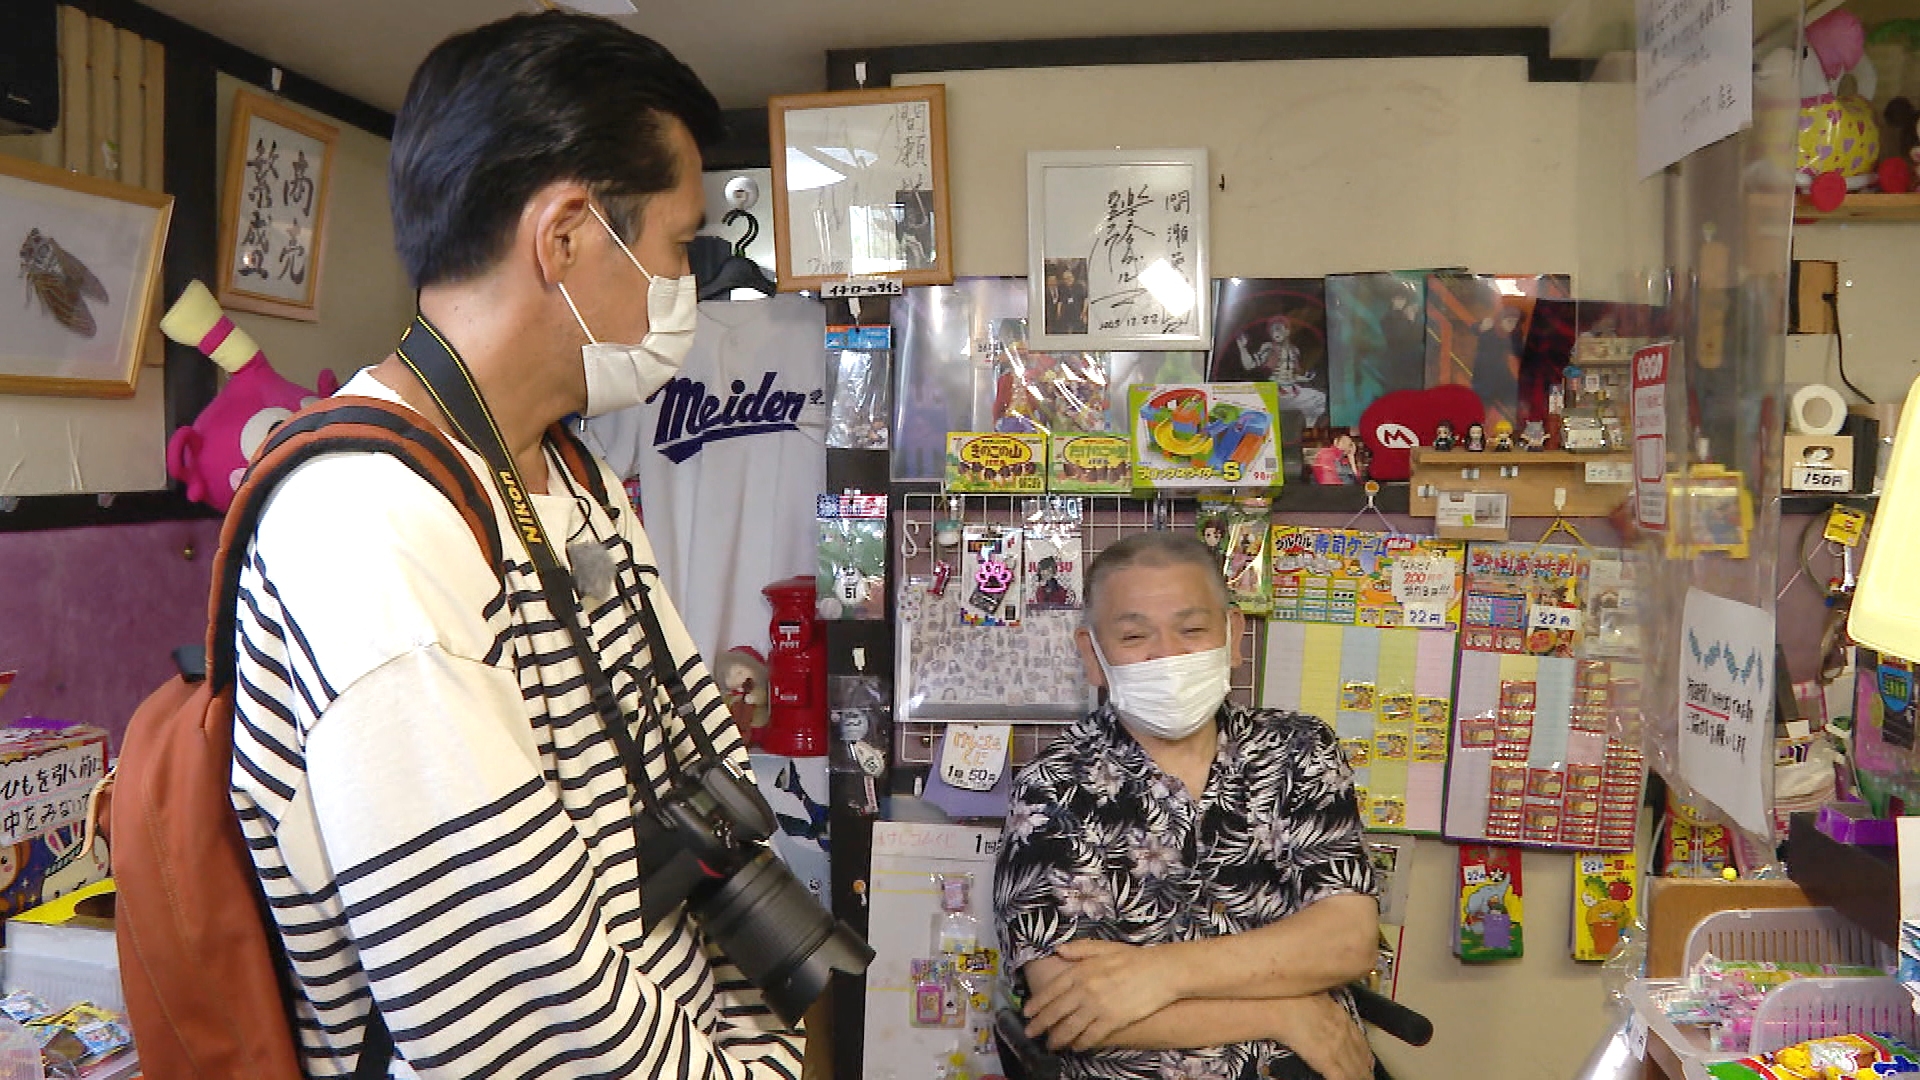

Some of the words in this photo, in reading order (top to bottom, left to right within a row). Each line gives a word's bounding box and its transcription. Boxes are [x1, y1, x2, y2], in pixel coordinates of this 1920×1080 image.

[644, 371, 806, 447] Meiden
[970, 444, 1023, 459] きのこの山
[1222, 460, 1242, 482] S
[1804, 472, 1843, 486] 150円
[844, 587, 857, 599] 51
[1409, 609, 1441, 624] 22円
[1538, 612, 1571, 626] 22円
